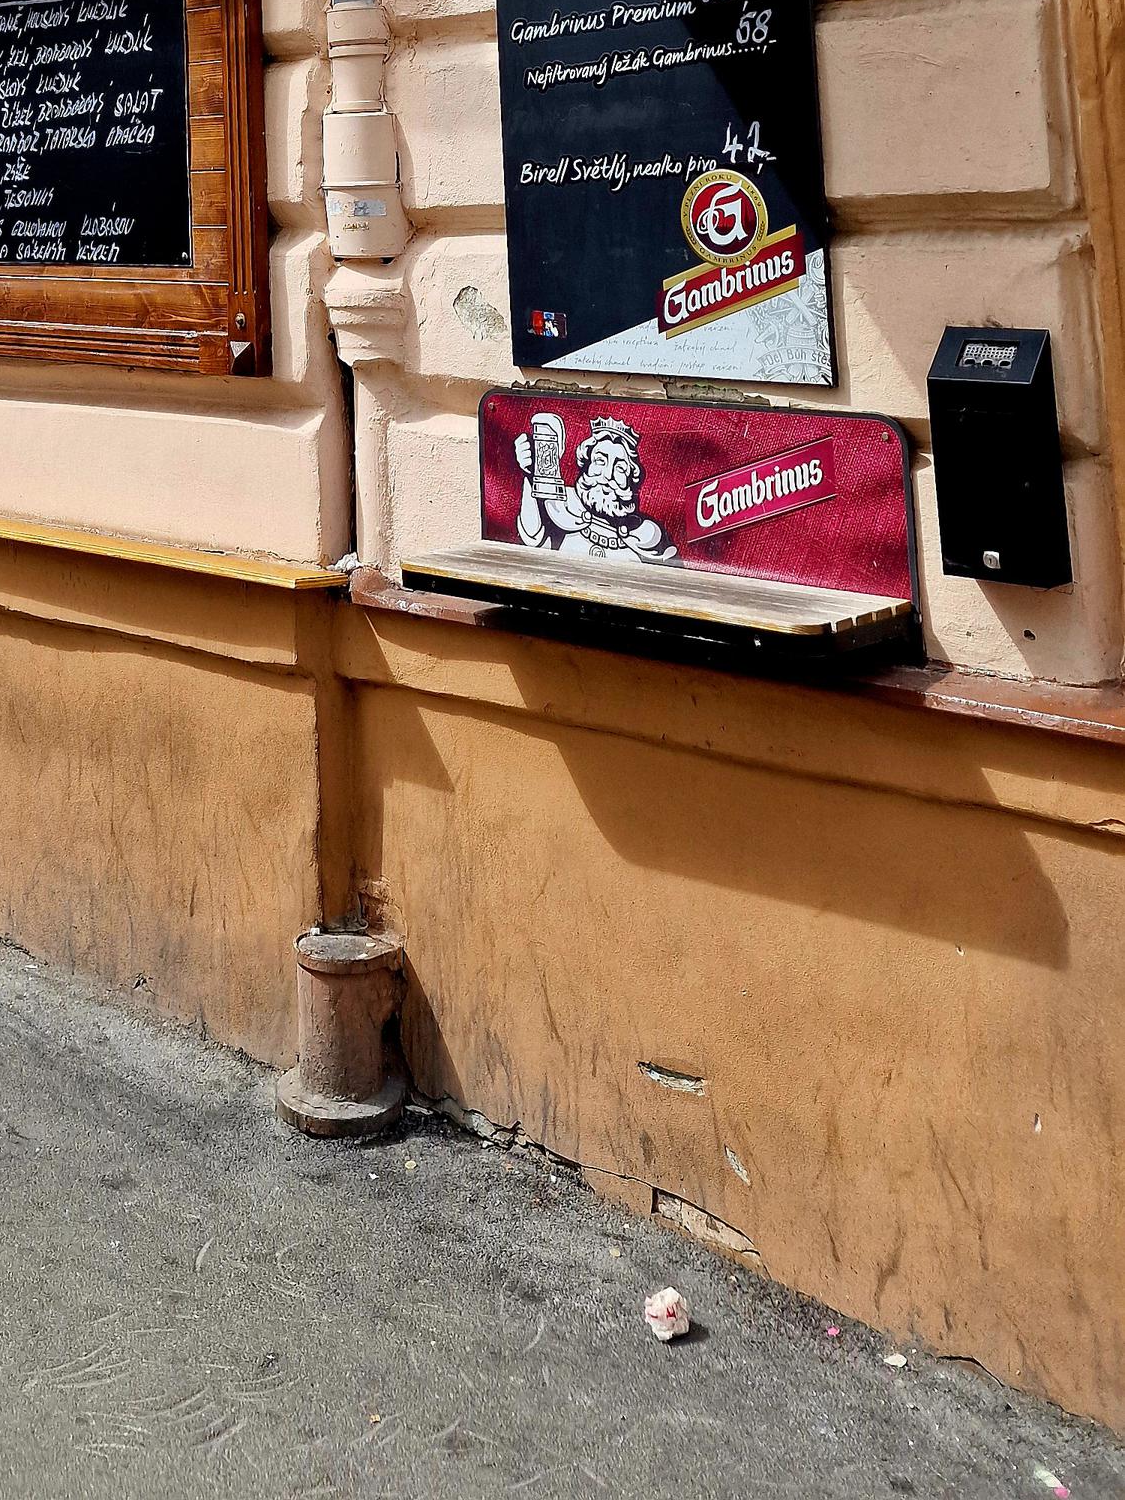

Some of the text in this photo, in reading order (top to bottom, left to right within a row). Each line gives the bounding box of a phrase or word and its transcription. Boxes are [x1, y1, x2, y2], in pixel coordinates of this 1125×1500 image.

[510, 12, 607, 45] Gambrinus
[527, 58, 608, 91] Nefiltrovaný
[610, 51, 650, 75] ležák
[520, 157, 570, 184] Birell
[571, 153, 632, 192] Světlý,
[633, 154, 683, 177] nealko
[686, 155, 717, 182] pivo
[699, 246, 758, 264] GAMBRINUS
[663, 249, 796, 326] Gambrinus
[696, 458, 823, 529] Gambrinus
